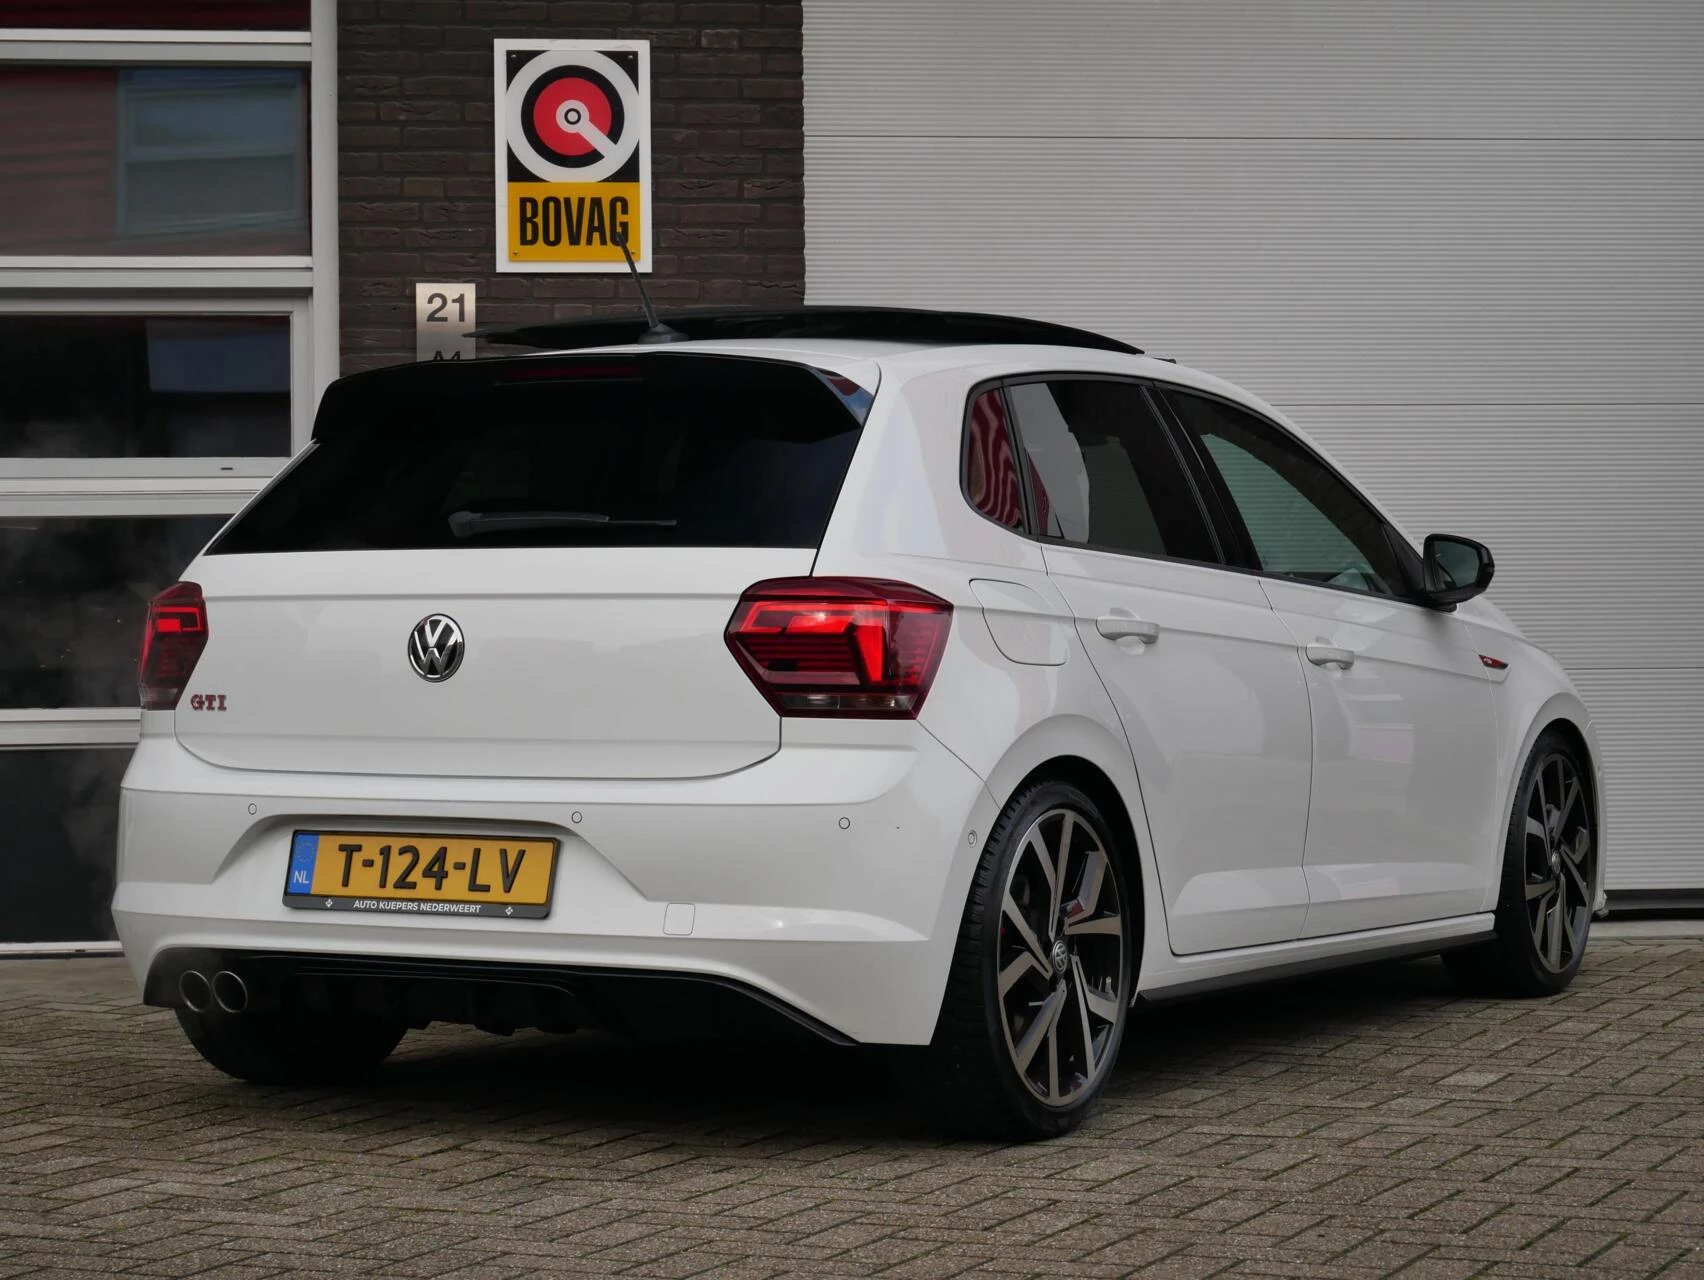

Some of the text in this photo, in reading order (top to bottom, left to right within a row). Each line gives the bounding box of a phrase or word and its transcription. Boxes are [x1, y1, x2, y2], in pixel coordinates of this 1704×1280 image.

[519, 196, 629, 246] BOVAG
[426, 293, 466, 322] 21
[191, 694, 227, 711] GTI
[293, 870, 309, 884] NL
[338, 843, 527, 893] T-124-LV
[353, 900, 481, 913] AUTO KUEPERS NEDERWEERT
